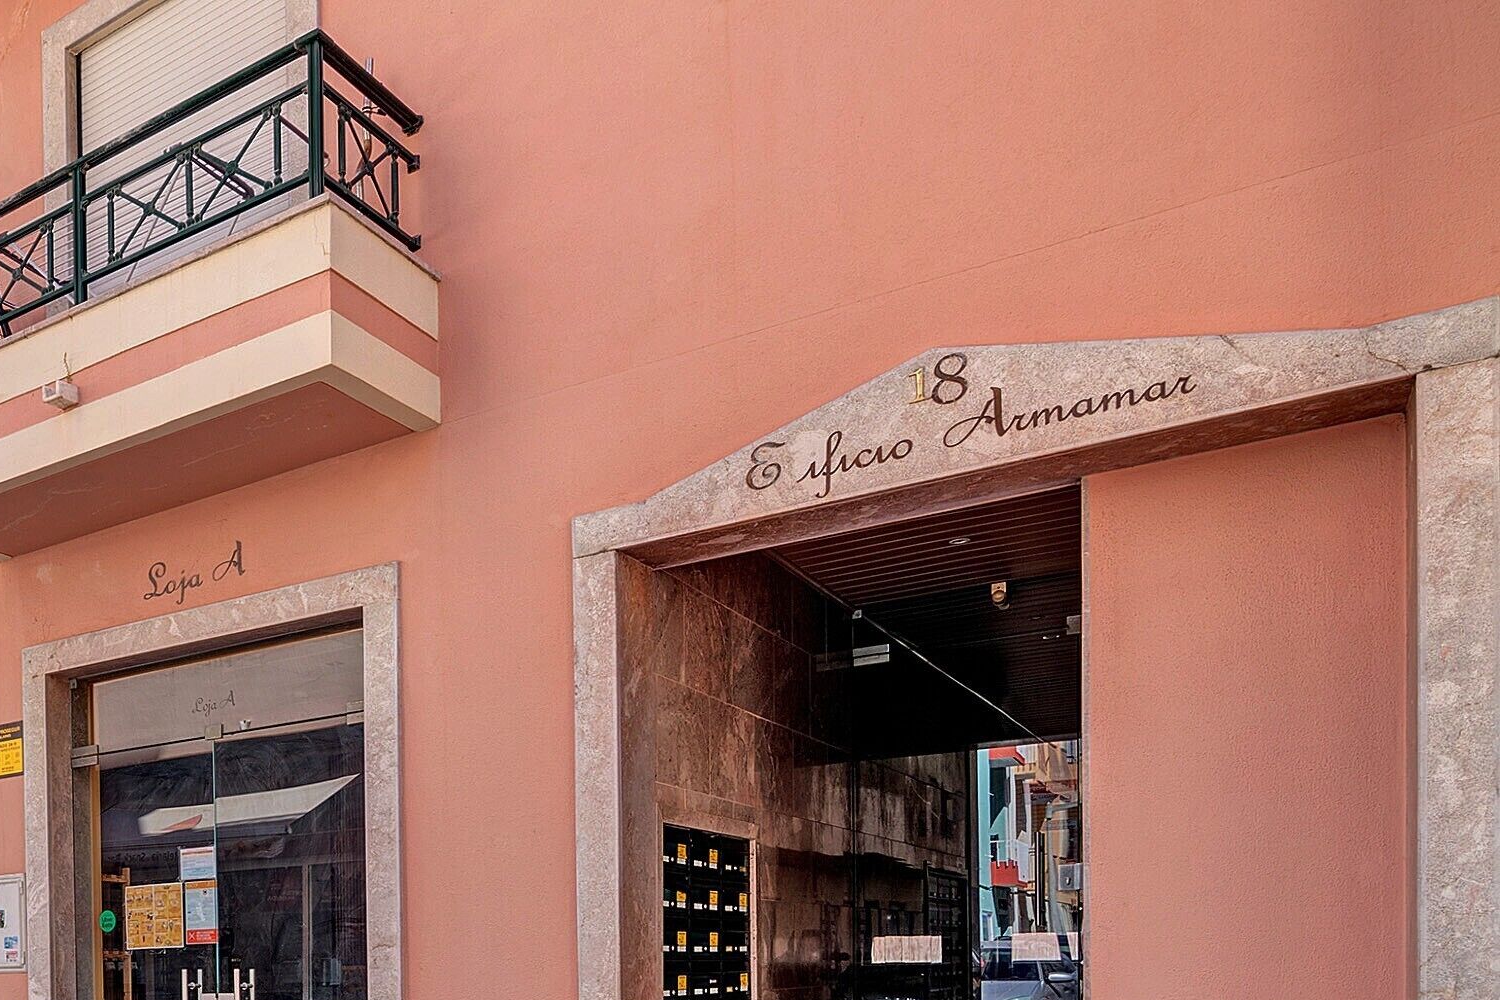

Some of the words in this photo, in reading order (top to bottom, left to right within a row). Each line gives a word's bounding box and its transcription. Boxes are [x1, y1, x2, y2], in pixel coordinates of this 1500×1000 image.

[908, 352, 968, 405] 18
[746, 430, 913, 499] Eificio
[943, 386, 1198, 448] Armamar
[143, 561, 204, 605] Loja
[212, 540, 246, 582] A
[192, 697, 217, 717] Loja
[219, 689, 236, 706] A
